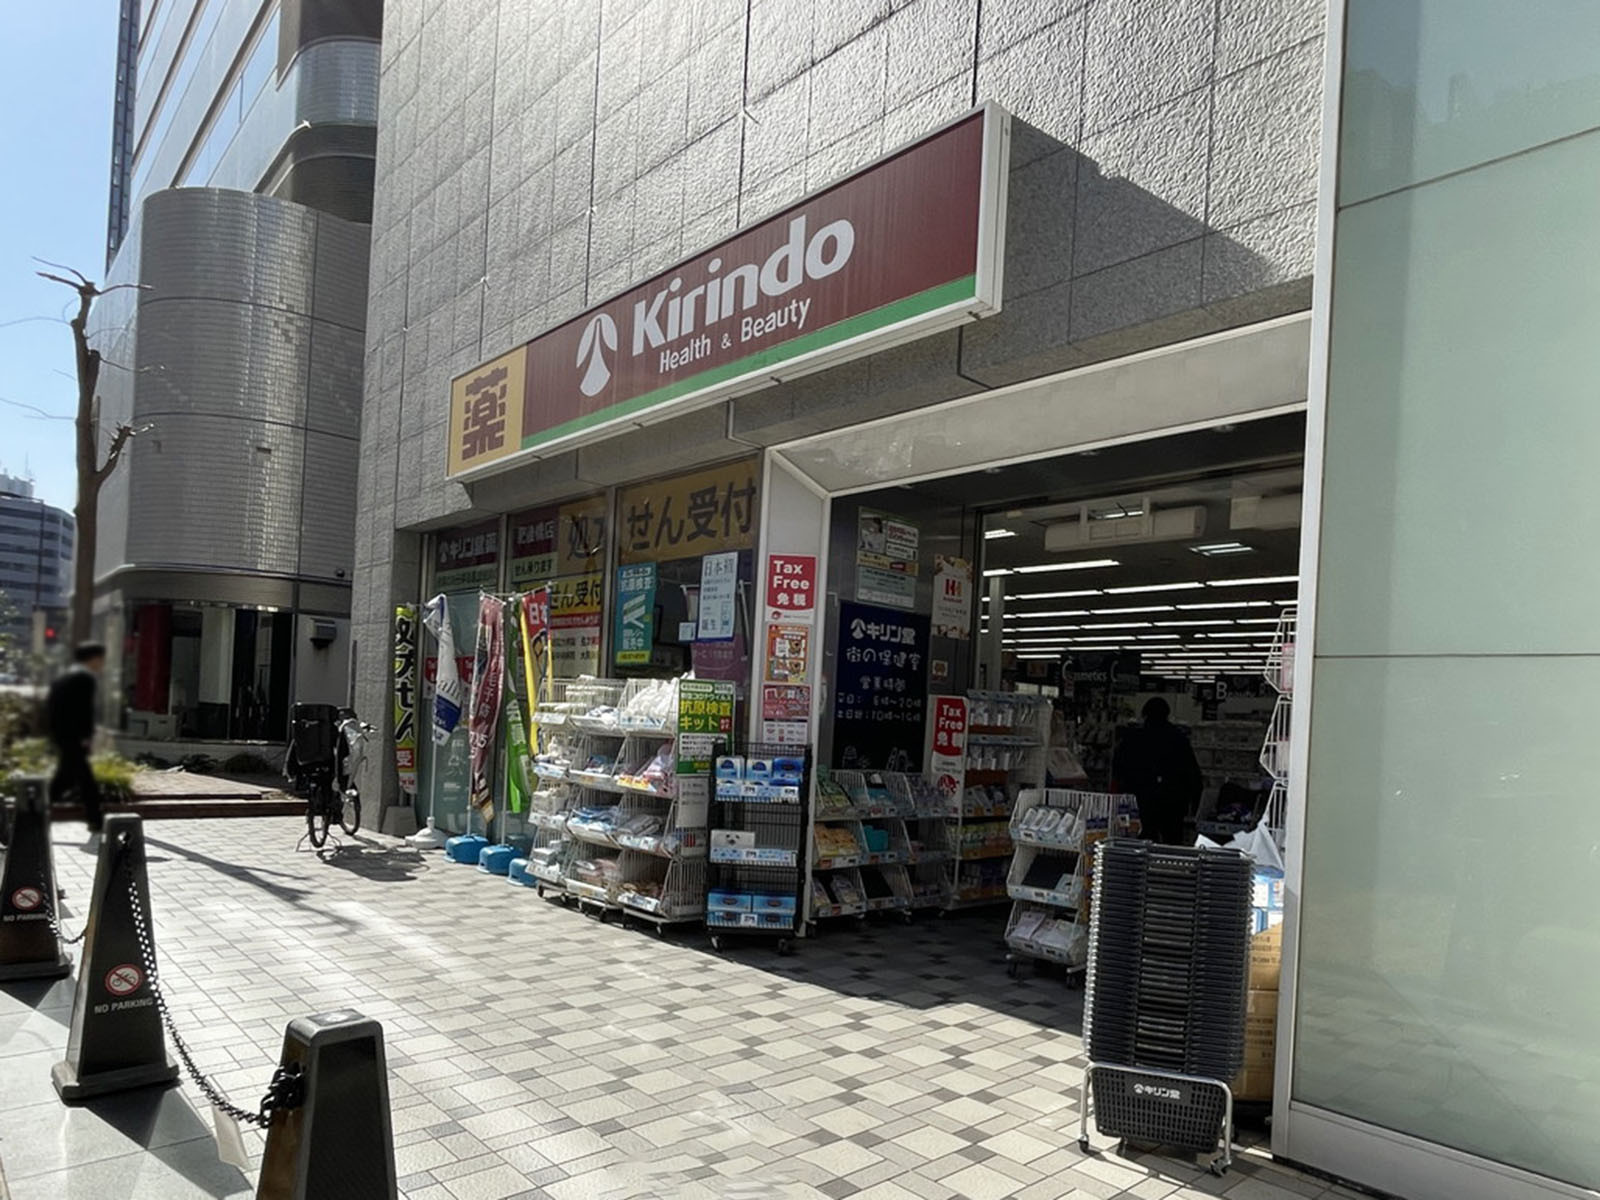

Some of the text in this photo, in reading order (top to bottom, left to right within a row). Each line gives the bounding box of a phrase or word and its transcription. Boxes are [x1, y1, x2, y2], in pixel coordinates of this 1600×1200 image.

[632, 214, 855, 356] Kirindo
[659, 297, 811, 374] Health & Beauty
[461, 366, 508, 461] 薬
[627, 477, 757, 550] せん受付
[773, 560, 803, 575] Tax
[773, 575, 810, 590] Free
[680, 700, 732, 716] 抗原検査
[942, 704, 962, 718] Tax
[680, 715, 719, 731] キット
[938, 718, 964, 731] Free
[94, 1004, 109, 1014] NO
